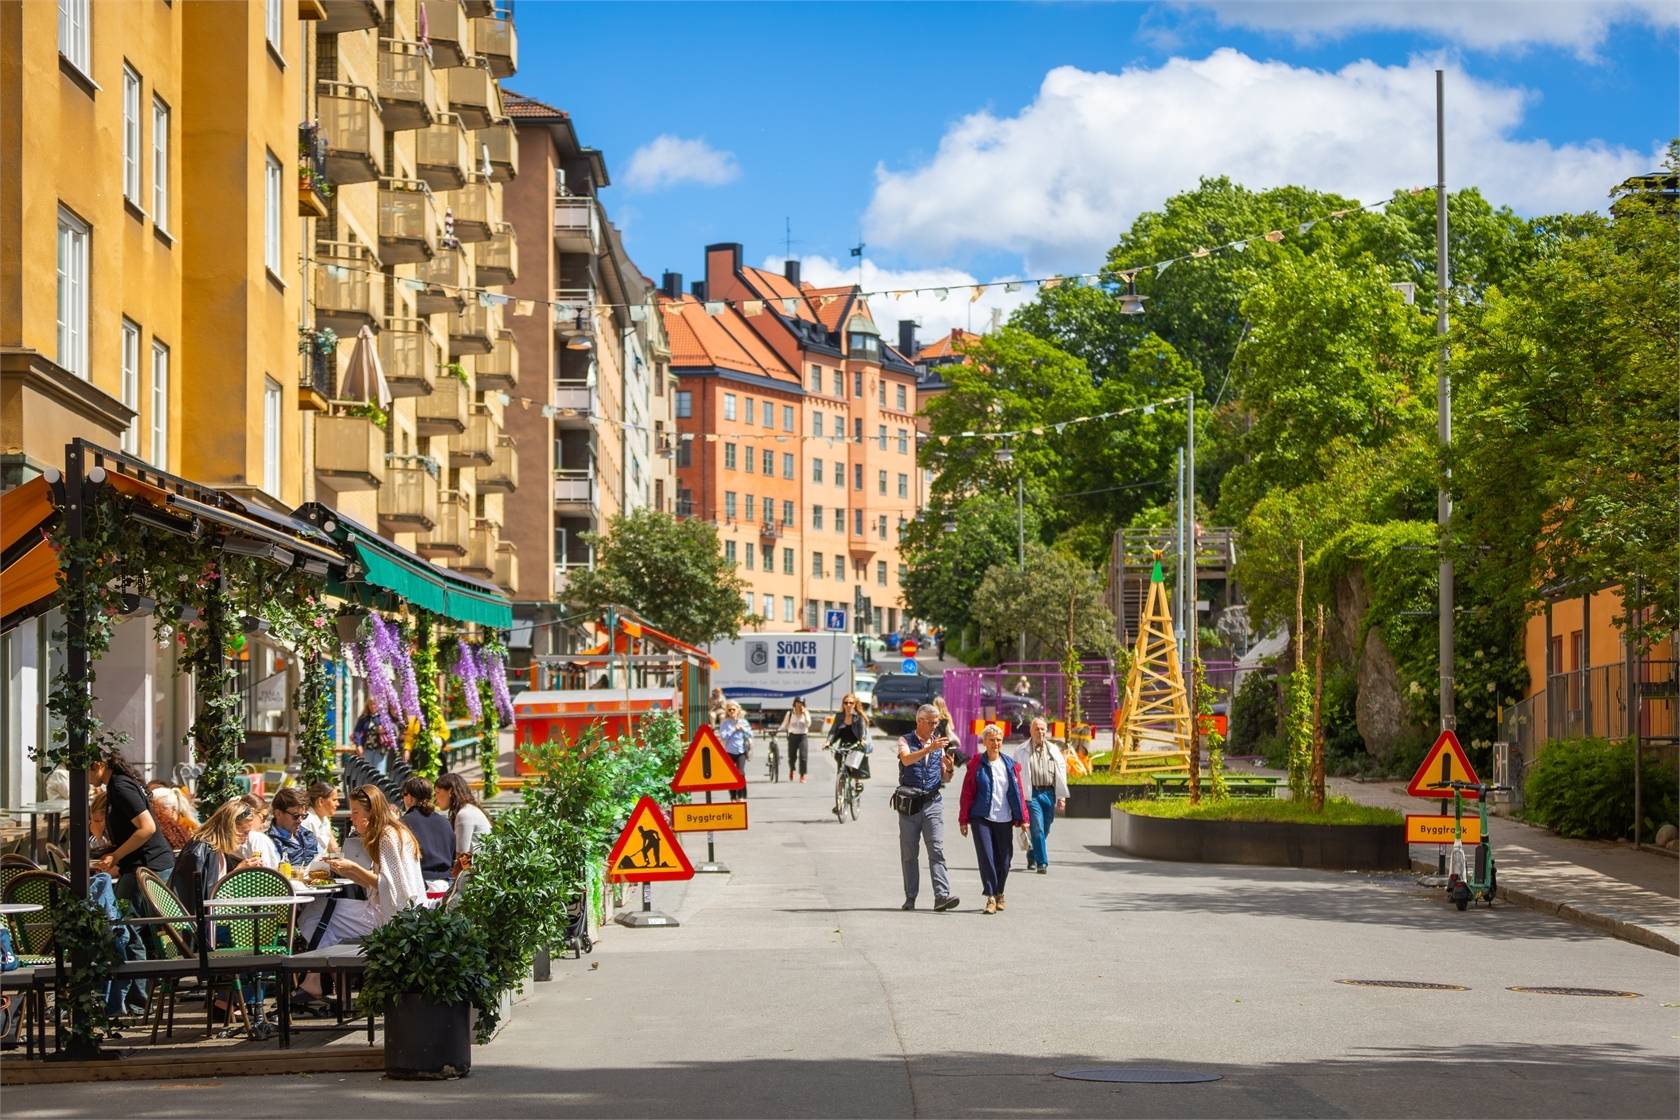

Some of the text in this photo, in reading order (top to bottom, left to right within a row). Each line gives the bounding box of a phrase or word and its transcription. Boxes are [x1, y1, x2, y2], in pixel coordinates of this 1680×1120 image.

[785, 655, 811, 670] KYL
[686, 812, 733, 823] Byggtrafik
[1420, 824, 1467, 835] Byggtrak
